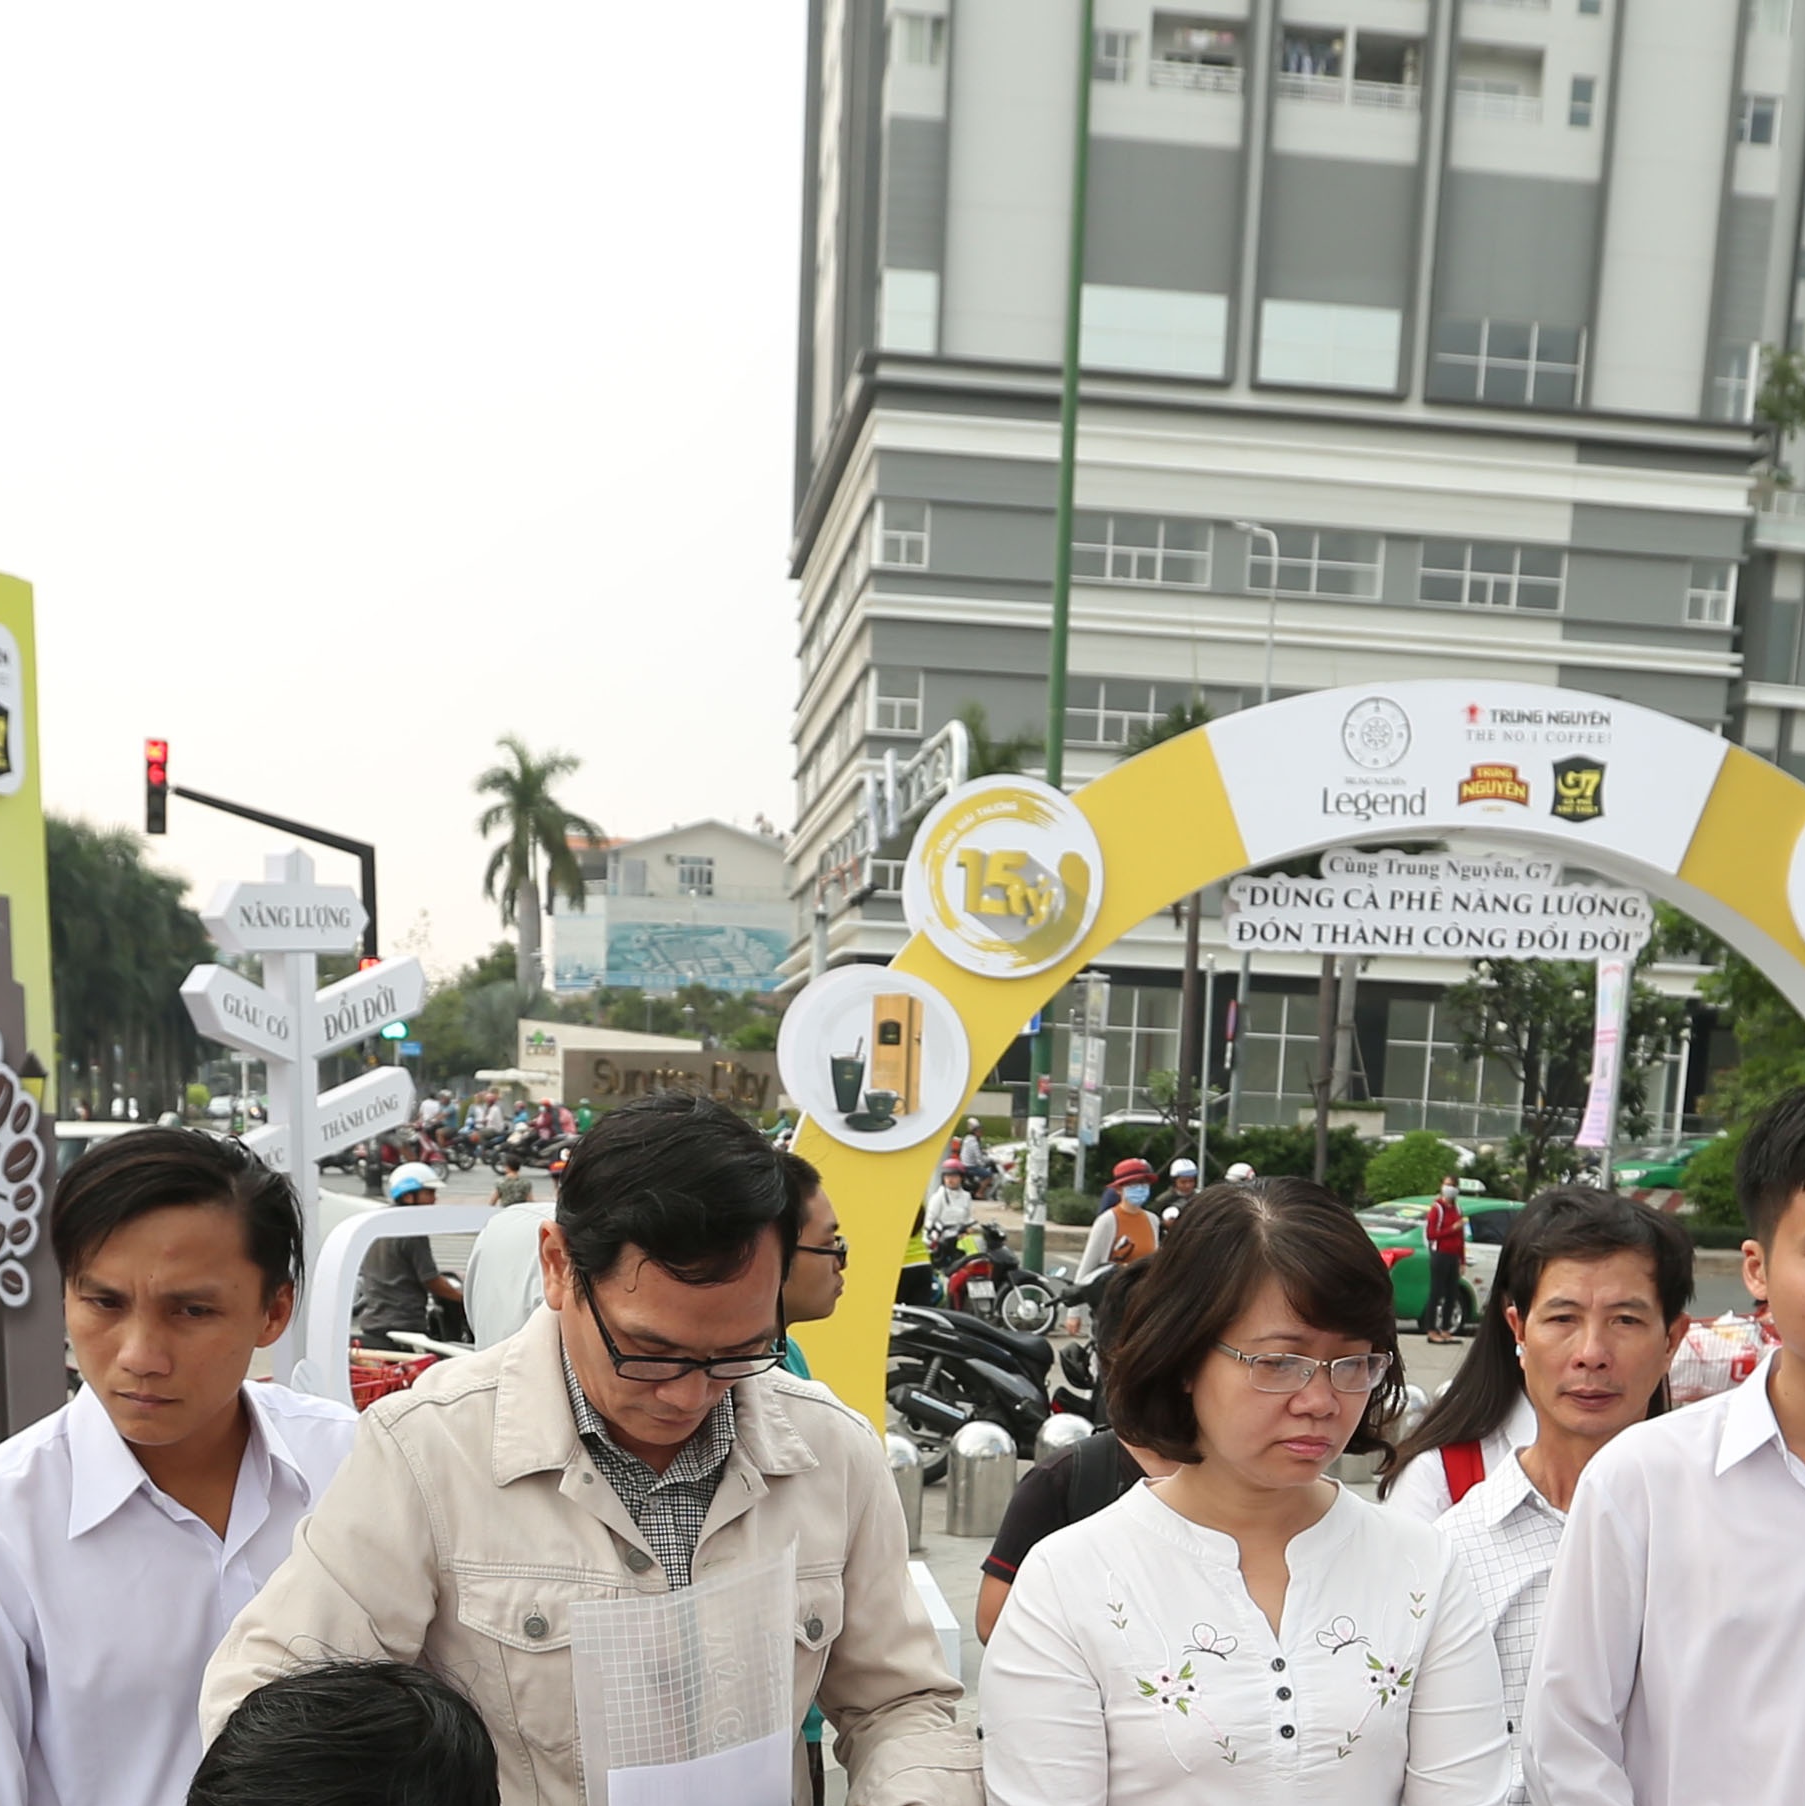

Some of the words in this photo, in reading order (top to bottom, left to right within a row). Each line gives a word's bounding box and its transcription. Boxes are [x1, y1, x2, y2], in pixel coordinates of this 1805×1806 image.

[1490, 708, 1544, 725] TRUNG
[1465, 729, 1496, 741] THE
[1475, 767, 1514, 779] TRUNG
[1556, 769, 1602, 799] G7
[1321, 786, 1427, 821] Legend
[1328, 855, 1379, 879] Cùng
[1385, 859, 1441, 881] Trung
[1446, 860, 1521, 883] Nguyên,
[1525, 861, 1553, 881] G7
[239, 901, 291, 929] NĂNG
[295, 903, 351, 935] LƯỢNG
[1236, 881, 1335, 910] “DÙNG
[1343, 882, 1381, 911] CÀ
[1389, 885, 1444, 913] PHÊ
[1450, 888, 1532, 916] NĂNG
[1541, 890, 1647, 922] LƯỢNG,
[1236, 916, 1304, 944] ĐÓN
[1311, 916, 1414, 949] THÀNH
[1423, 920, 1507, 949] CÔNG
[1516, 918, 1569, 952] ĐỔI
[1577, 927, 1645, 953] ĐỜI”
[222, 991, 263, 1029] GIÀU
[266, 1011, 289, 1041] CÓ
[323, 994, 360, 1042] ĐỔI
[362, 982, 399, 1025] ĐỜI
[710, 1060, 772, 1110] City
[320, 1109, 365, 1142] THÀNH
[365, 1092, 400, 1123] CÔNG
